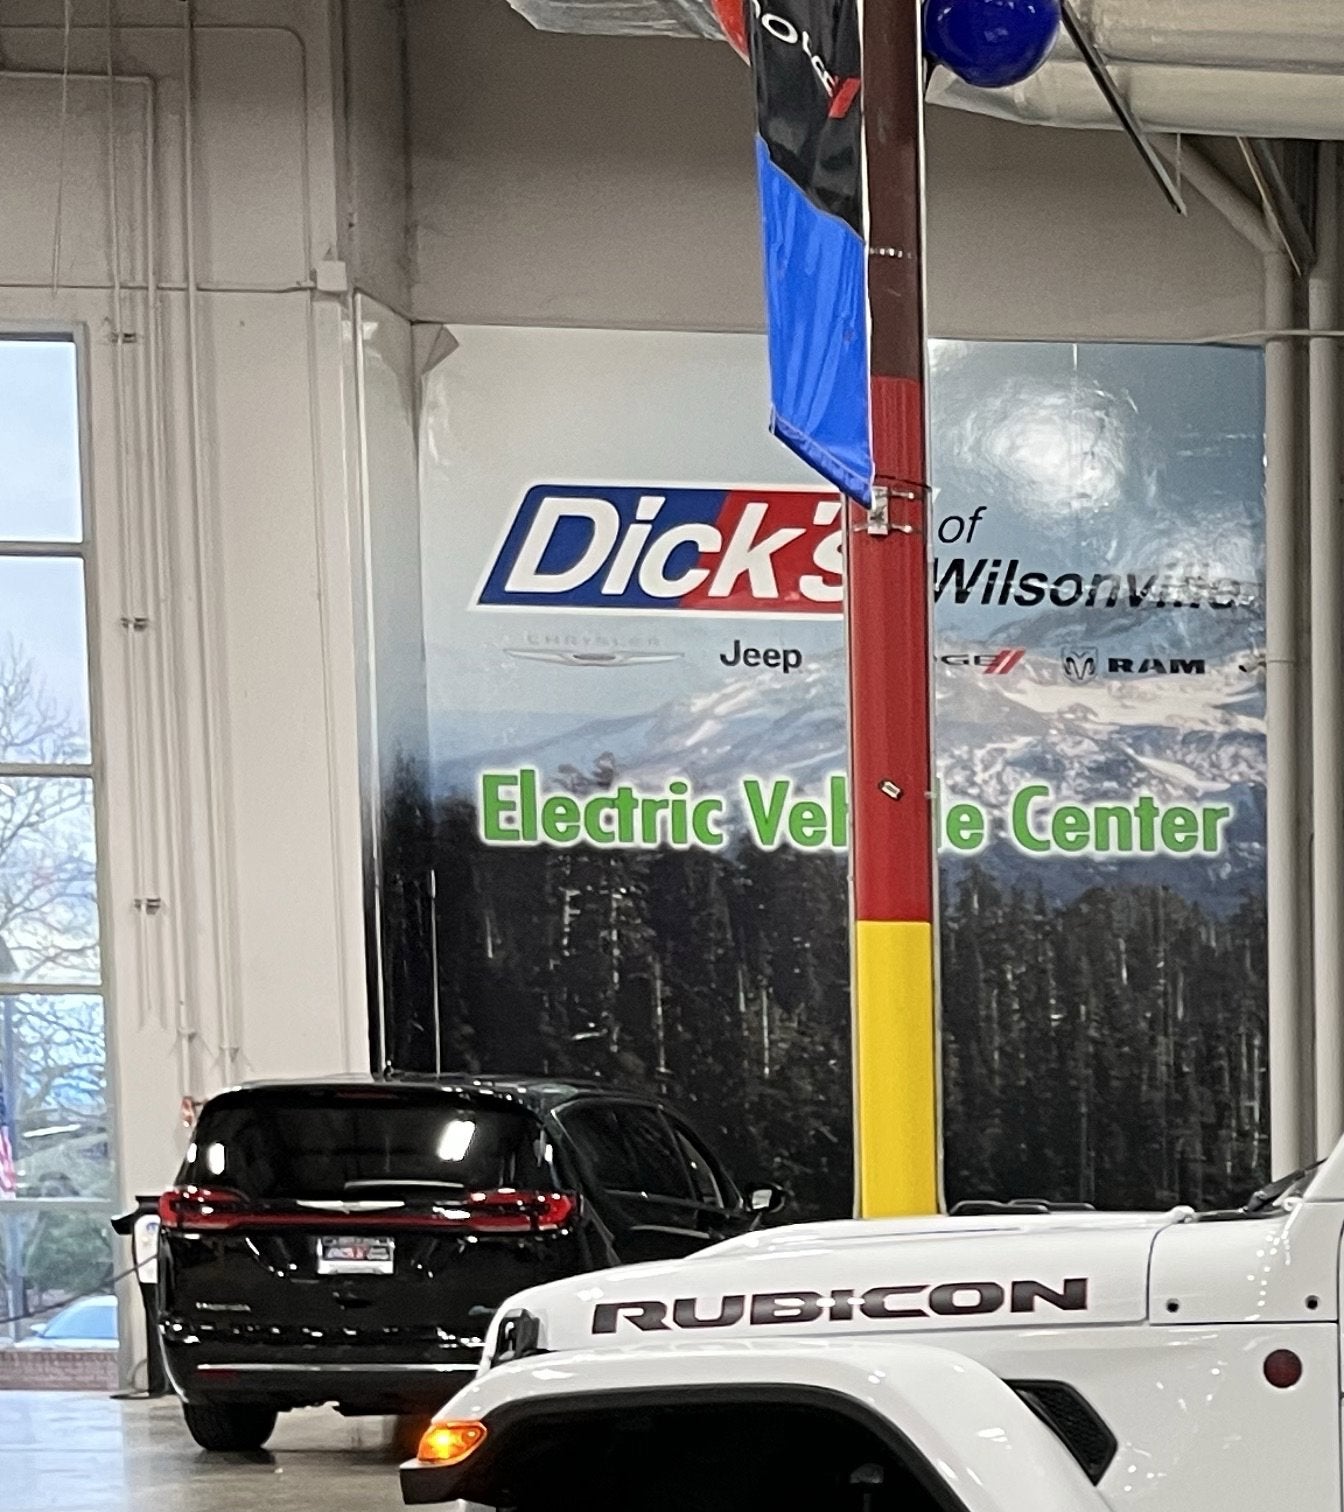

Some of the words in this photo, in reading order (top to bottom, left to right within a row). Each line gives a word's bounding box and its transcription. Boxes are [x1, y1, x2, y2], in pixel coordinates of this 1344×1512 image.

[937, 506, 987, 543] of
[720, 640, 802, 673] Jeep
[1108, 658, 1205, 674] RAM
[482, 769, 723, 845] Electric
[1012, 785, 1230, 851] Center
[591, 1277, 1088, 1334] RUBICON
